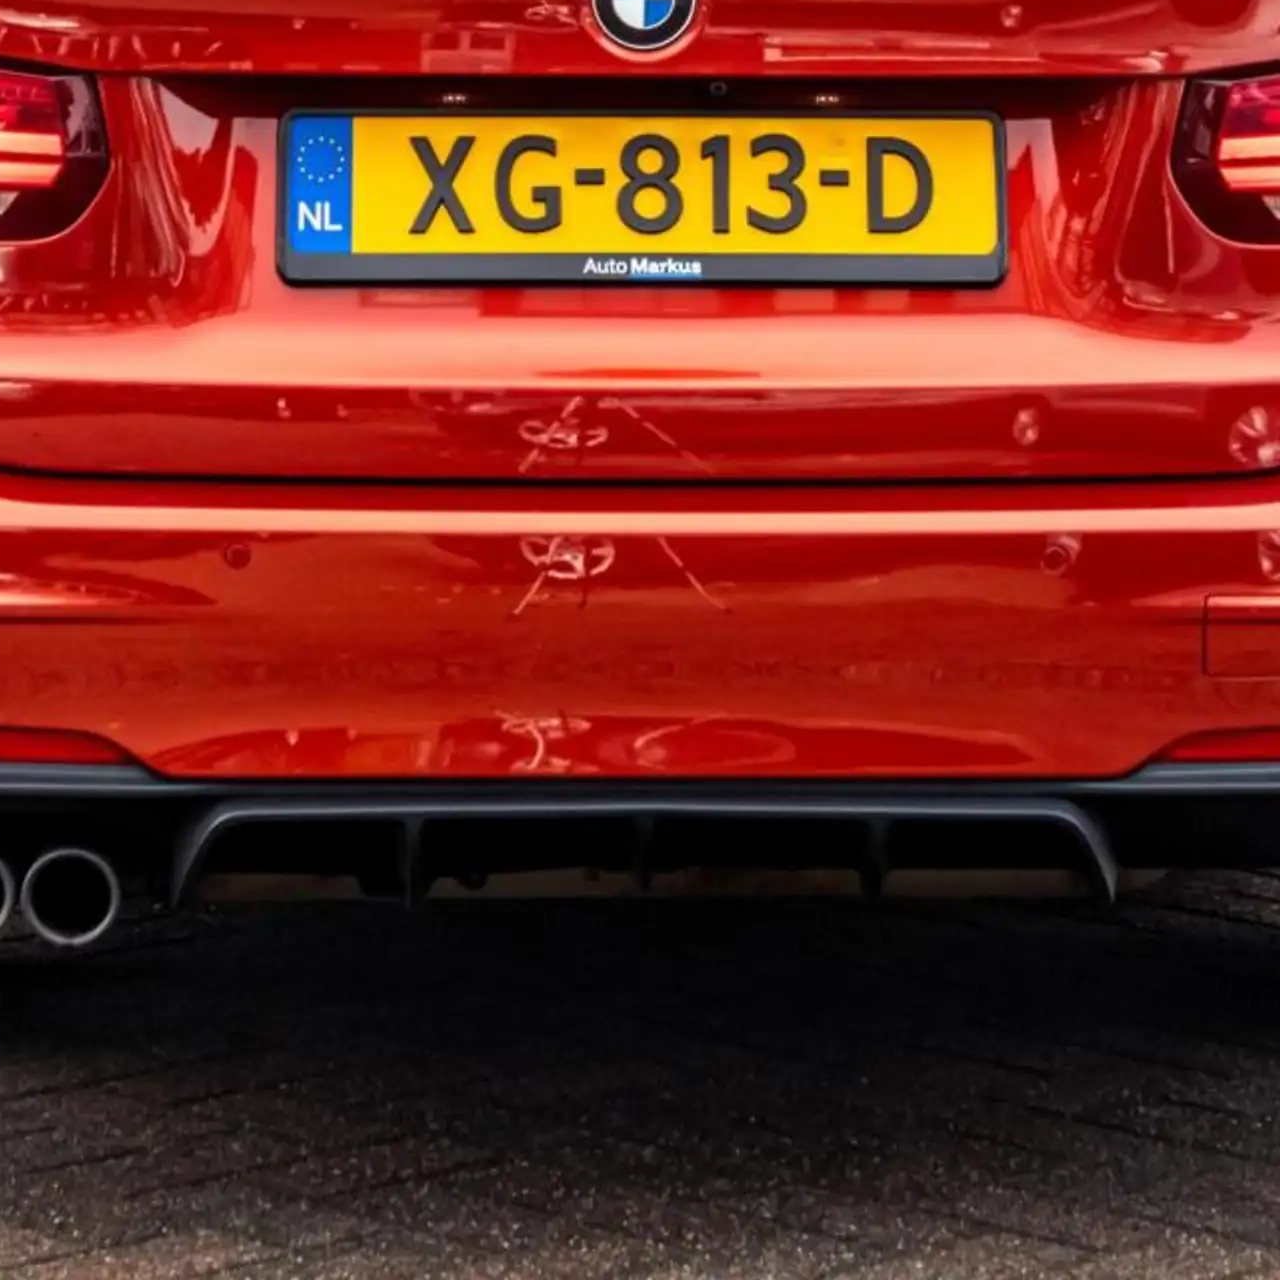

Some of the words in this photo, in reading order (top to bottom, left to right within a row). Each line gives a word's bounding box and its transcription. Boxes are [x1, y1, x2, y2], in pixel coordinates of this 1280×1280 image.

[410, 134, 932, 234] XG-813-D
[298, 200, 343, 231] NL
[583, 257, 627, 274] Auto
[630, 256, 701, 274] Markus
